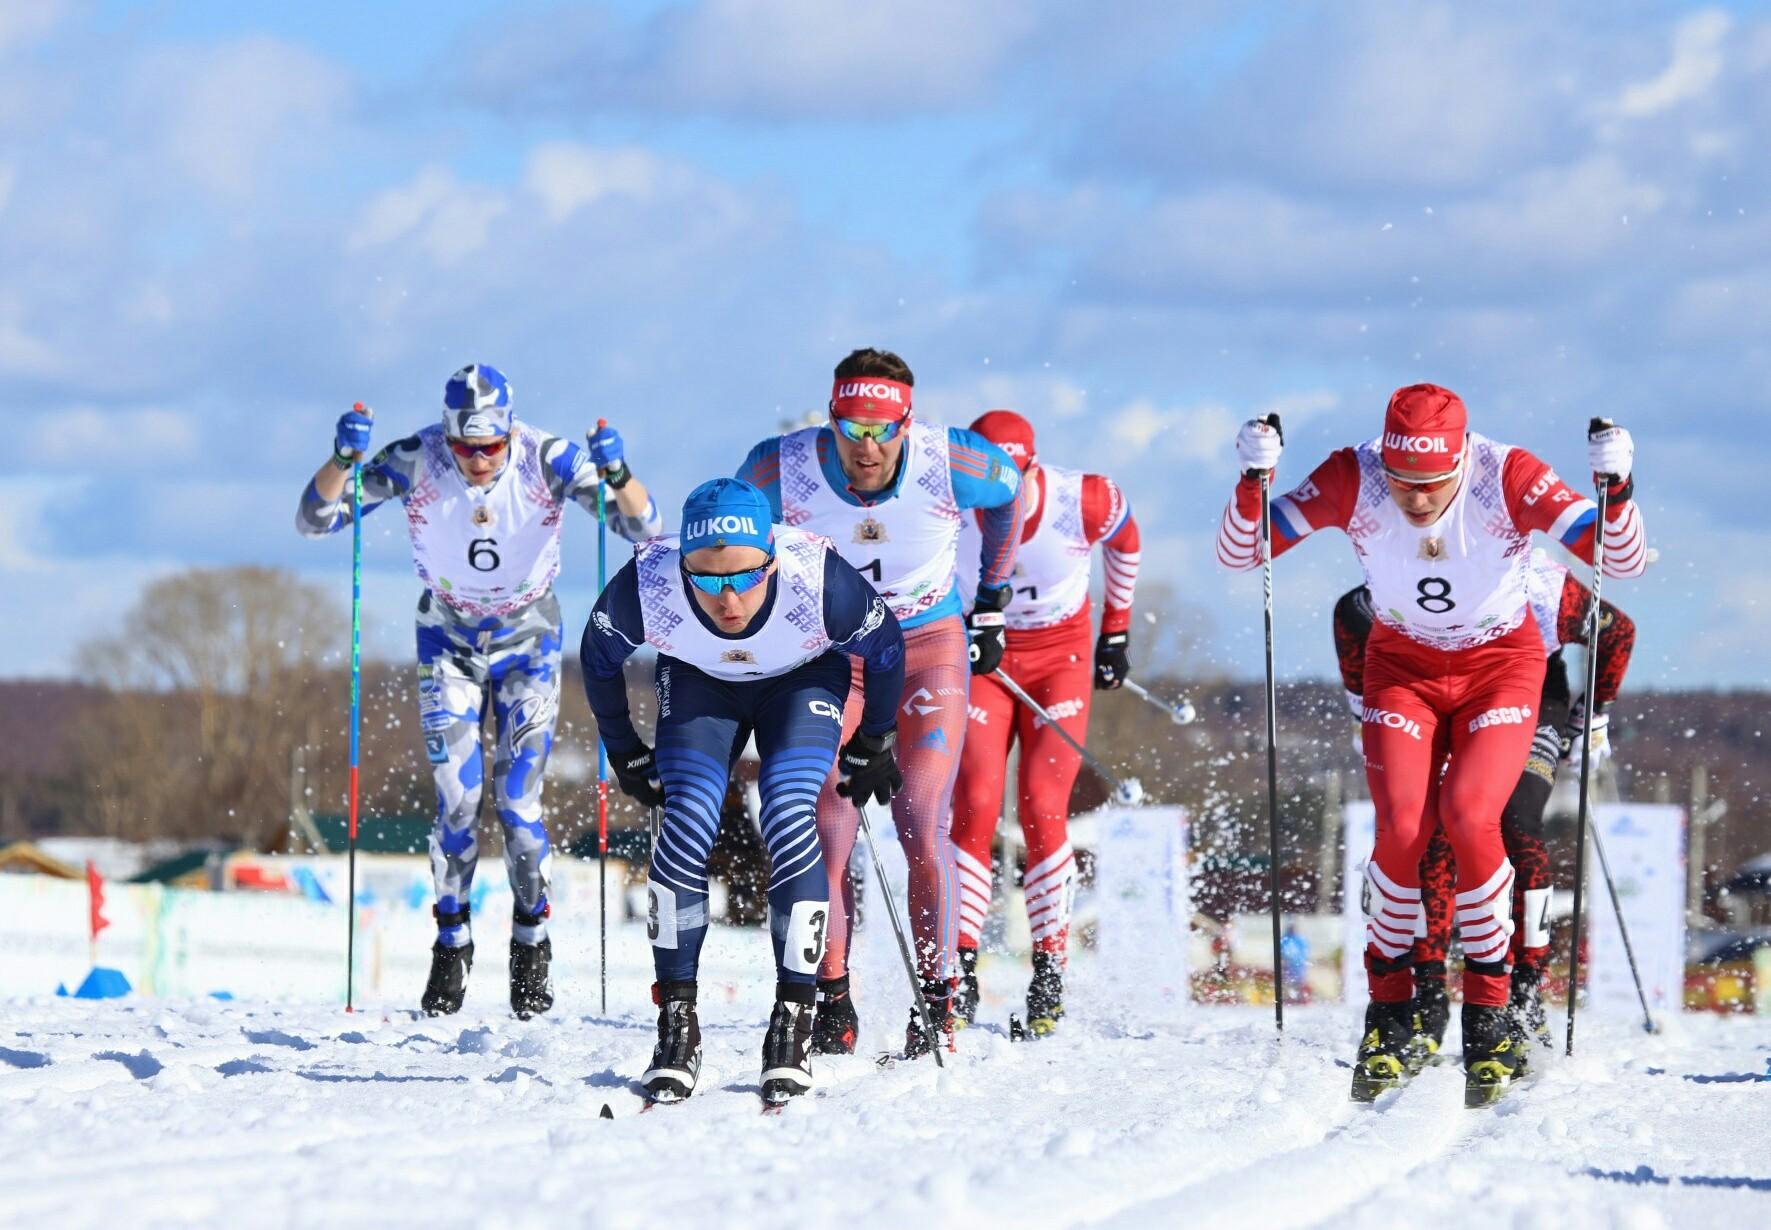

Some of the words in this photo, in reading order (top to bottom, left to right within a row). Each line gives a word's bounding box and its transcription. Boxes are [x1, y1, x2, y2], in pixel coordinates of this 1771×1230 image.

[838, 383, 903, 404] LUKOIL
[1385, 432, 1449, 453] LUKOIL
[687, 515, 759, 541] LUKOIL
[468, 538, 500, 572] 6
[856, 558, 882, 582] 1
[1416, 576, 1456, 614] 8
[1362, 707, 1423, 740] UKOIL
[1469, 706, 1523, 733] BOSCO
[803, 910, 826, 964] 3
